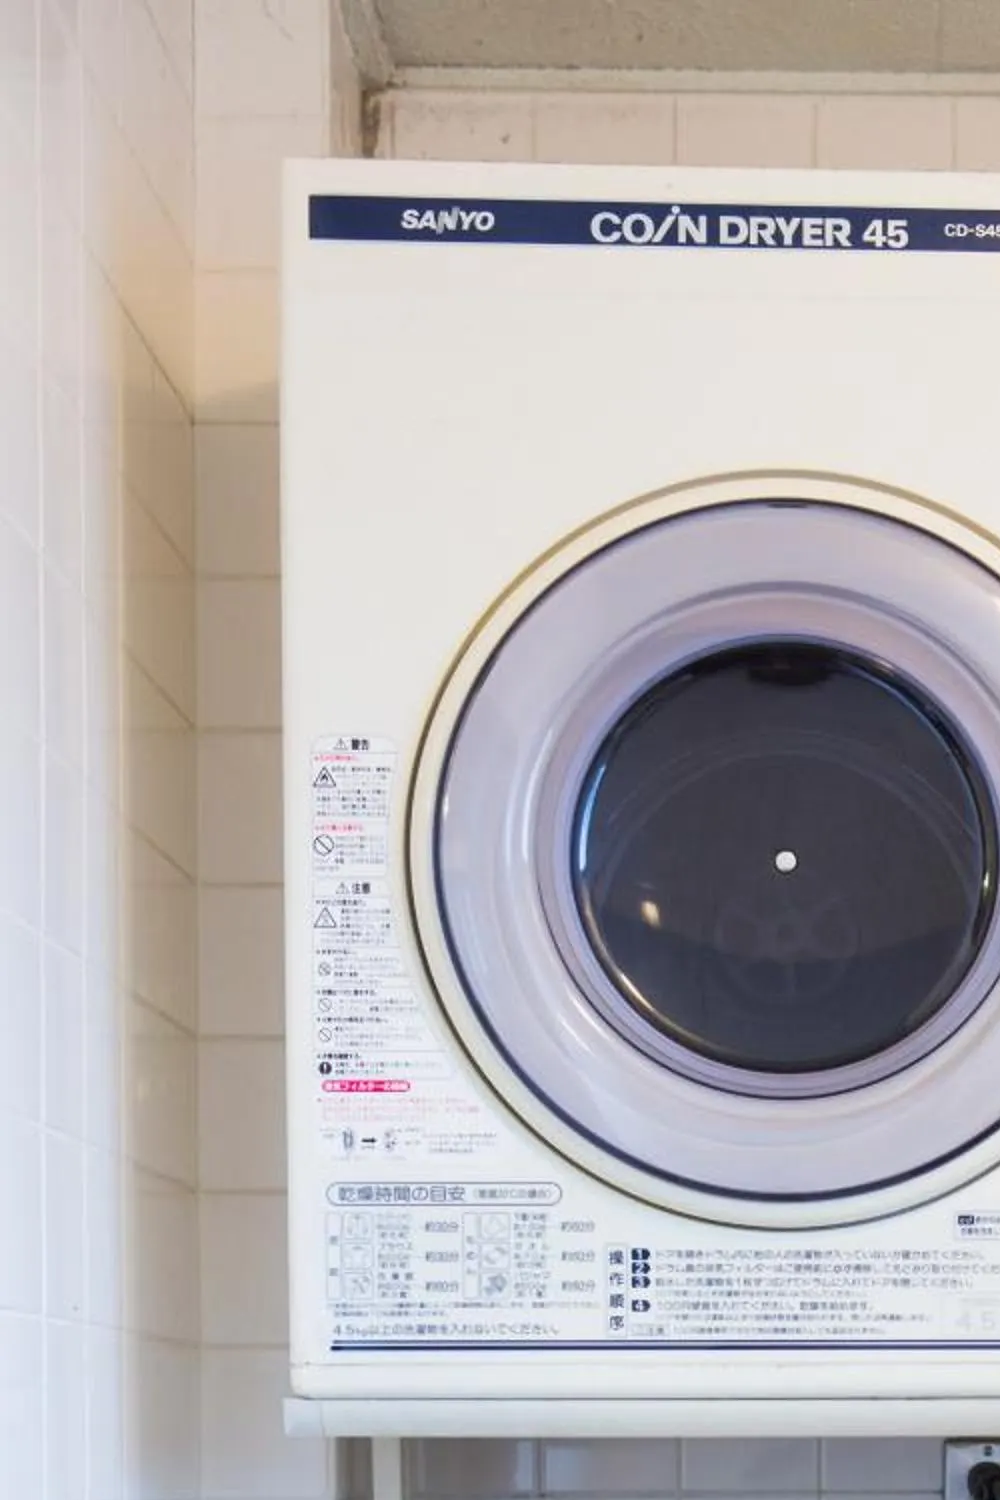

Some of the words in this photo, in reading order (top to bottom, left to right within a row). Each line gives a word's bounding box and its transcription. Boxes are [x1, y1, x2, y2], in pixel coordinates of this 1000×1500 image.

[400, 206, 495, 235] SANYO
[590, 204, 707, 248] COIN
[719, 216, 854, 249] DRYER
[861, 218, 909, 249] 45
